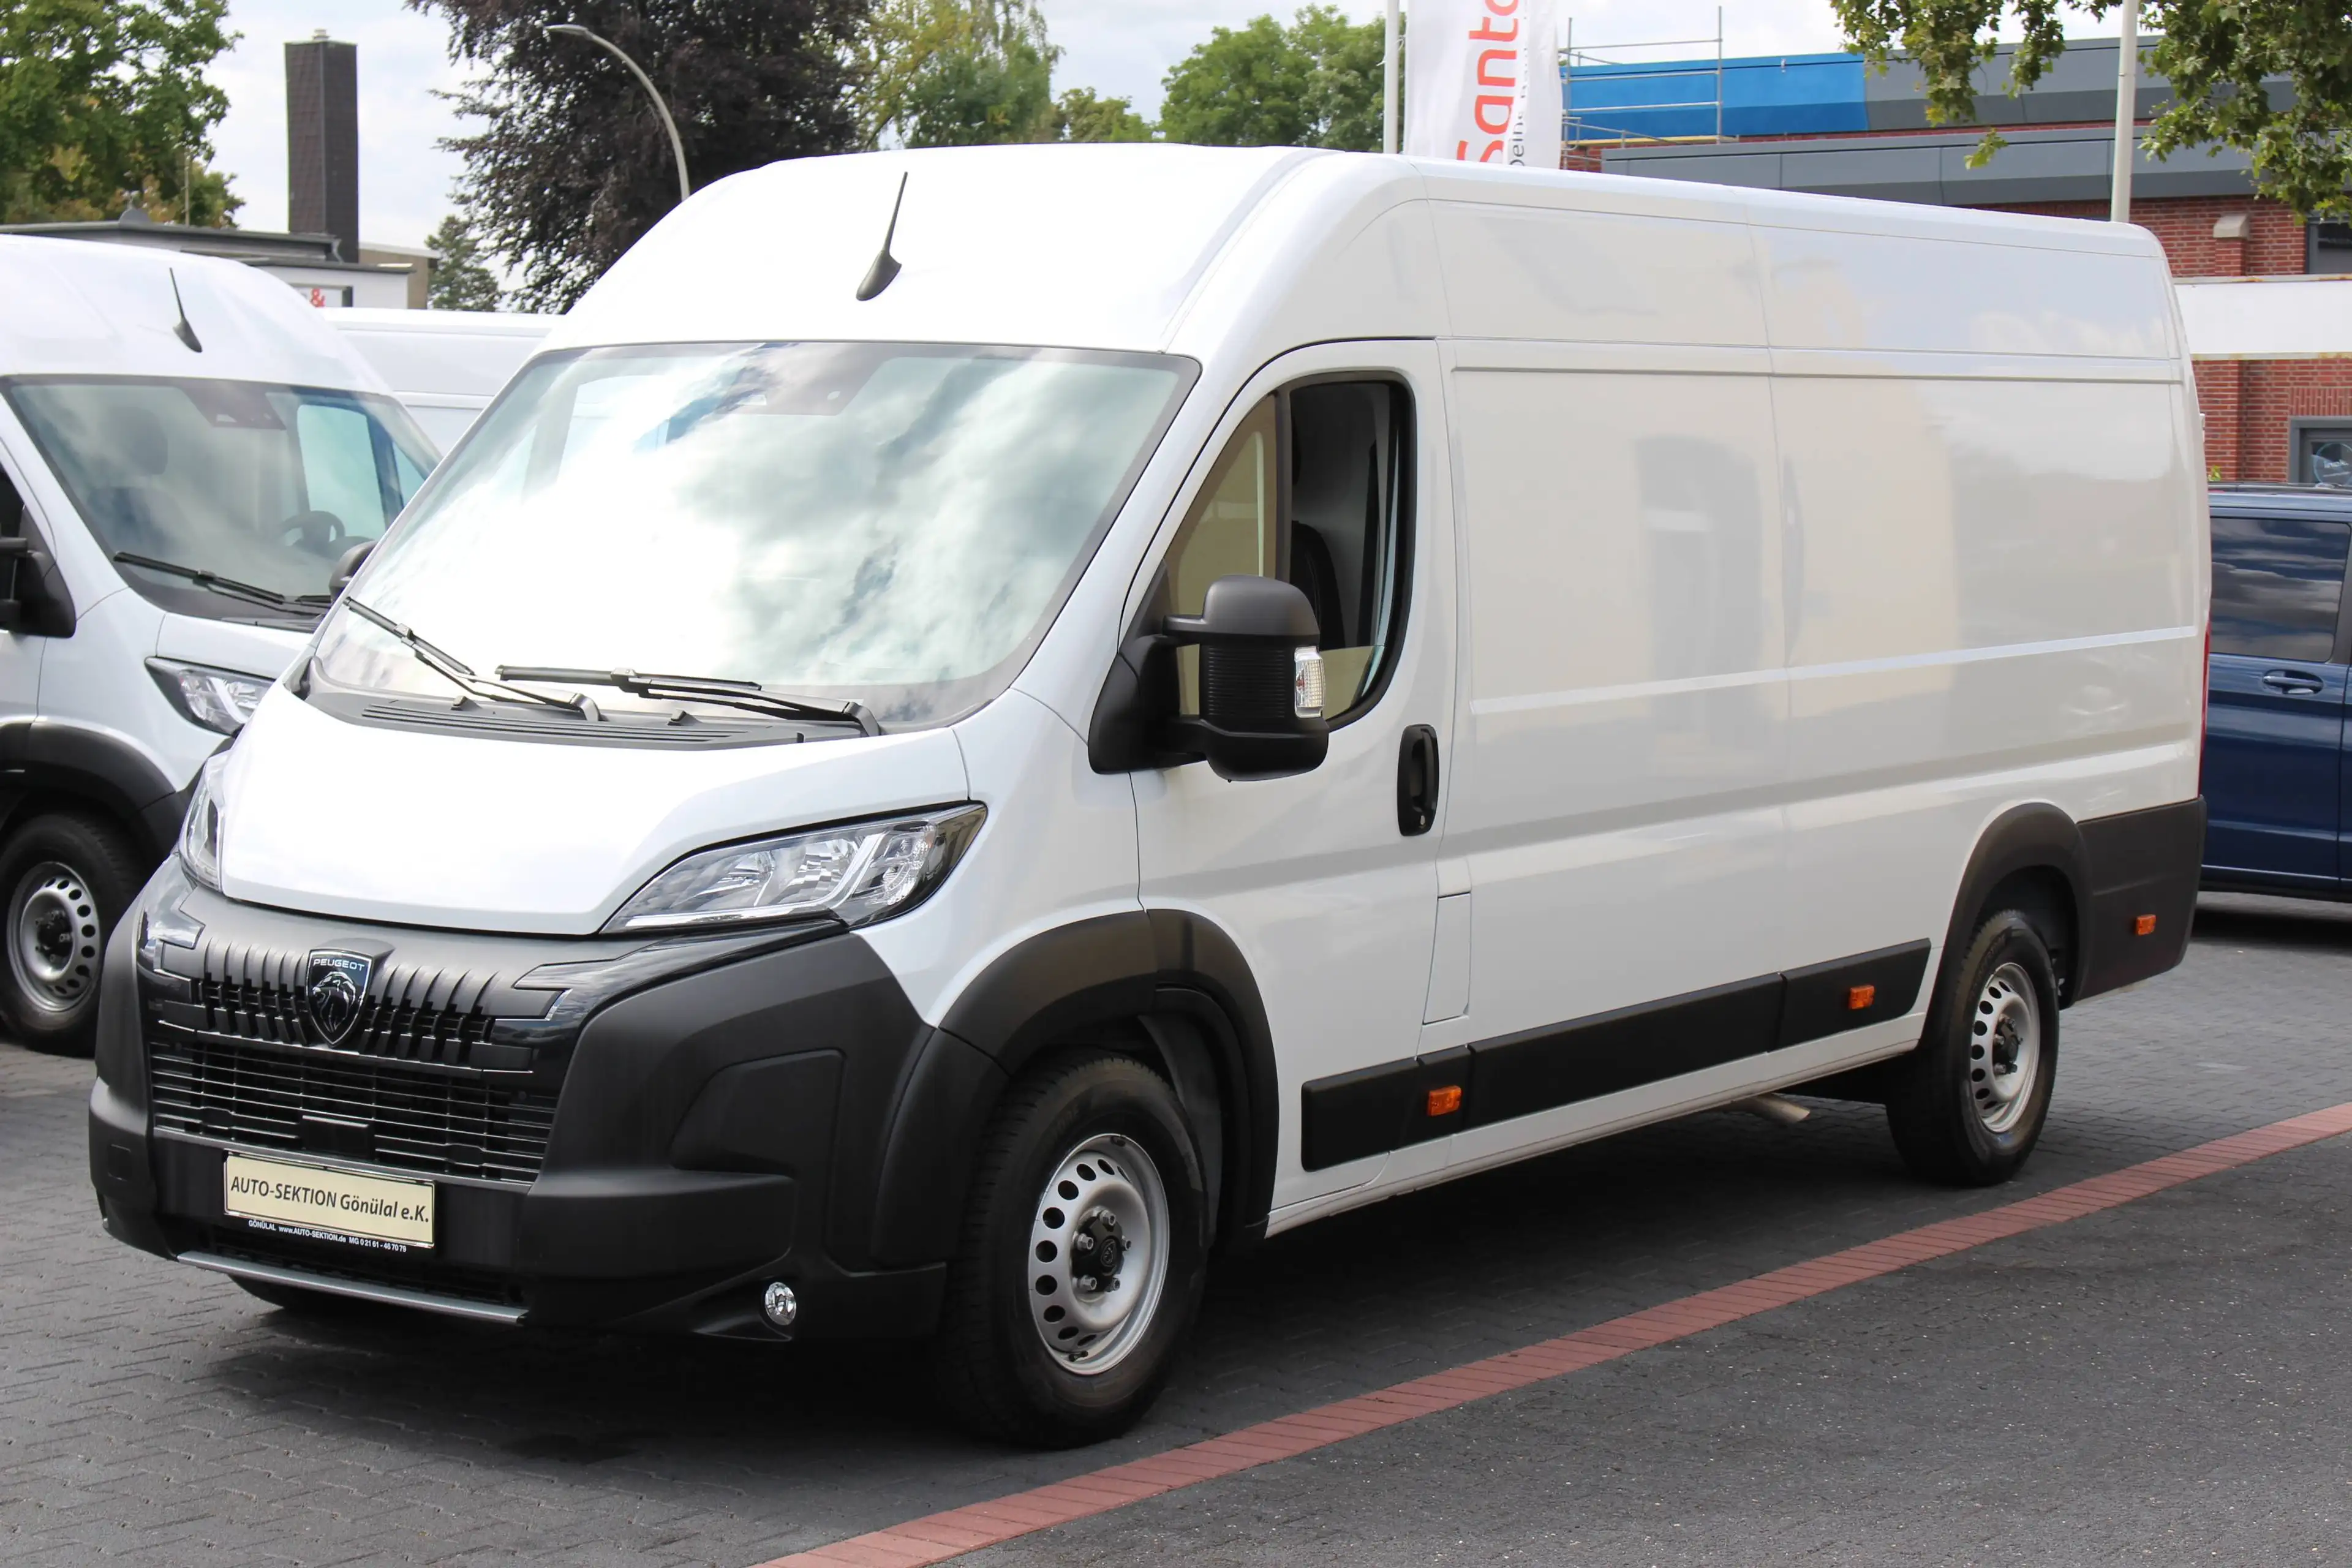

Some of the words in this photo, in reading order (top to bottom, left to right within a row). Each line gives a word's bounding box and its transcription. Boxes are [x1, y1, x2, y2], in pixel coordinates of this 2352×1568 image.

[313, 959, 365, 971] PEUGEOT
[230, 1176, 337, 1208] AUTO-SEKTION
[340, 1194, 398, 1218] Gönülal
[401, 1205, 429, 1223] e.K.
[248, 1219, 276, 1231] GÖNÜLAL
[278, 1226, 347, 1243] www.AUTO-SEKTION.de
